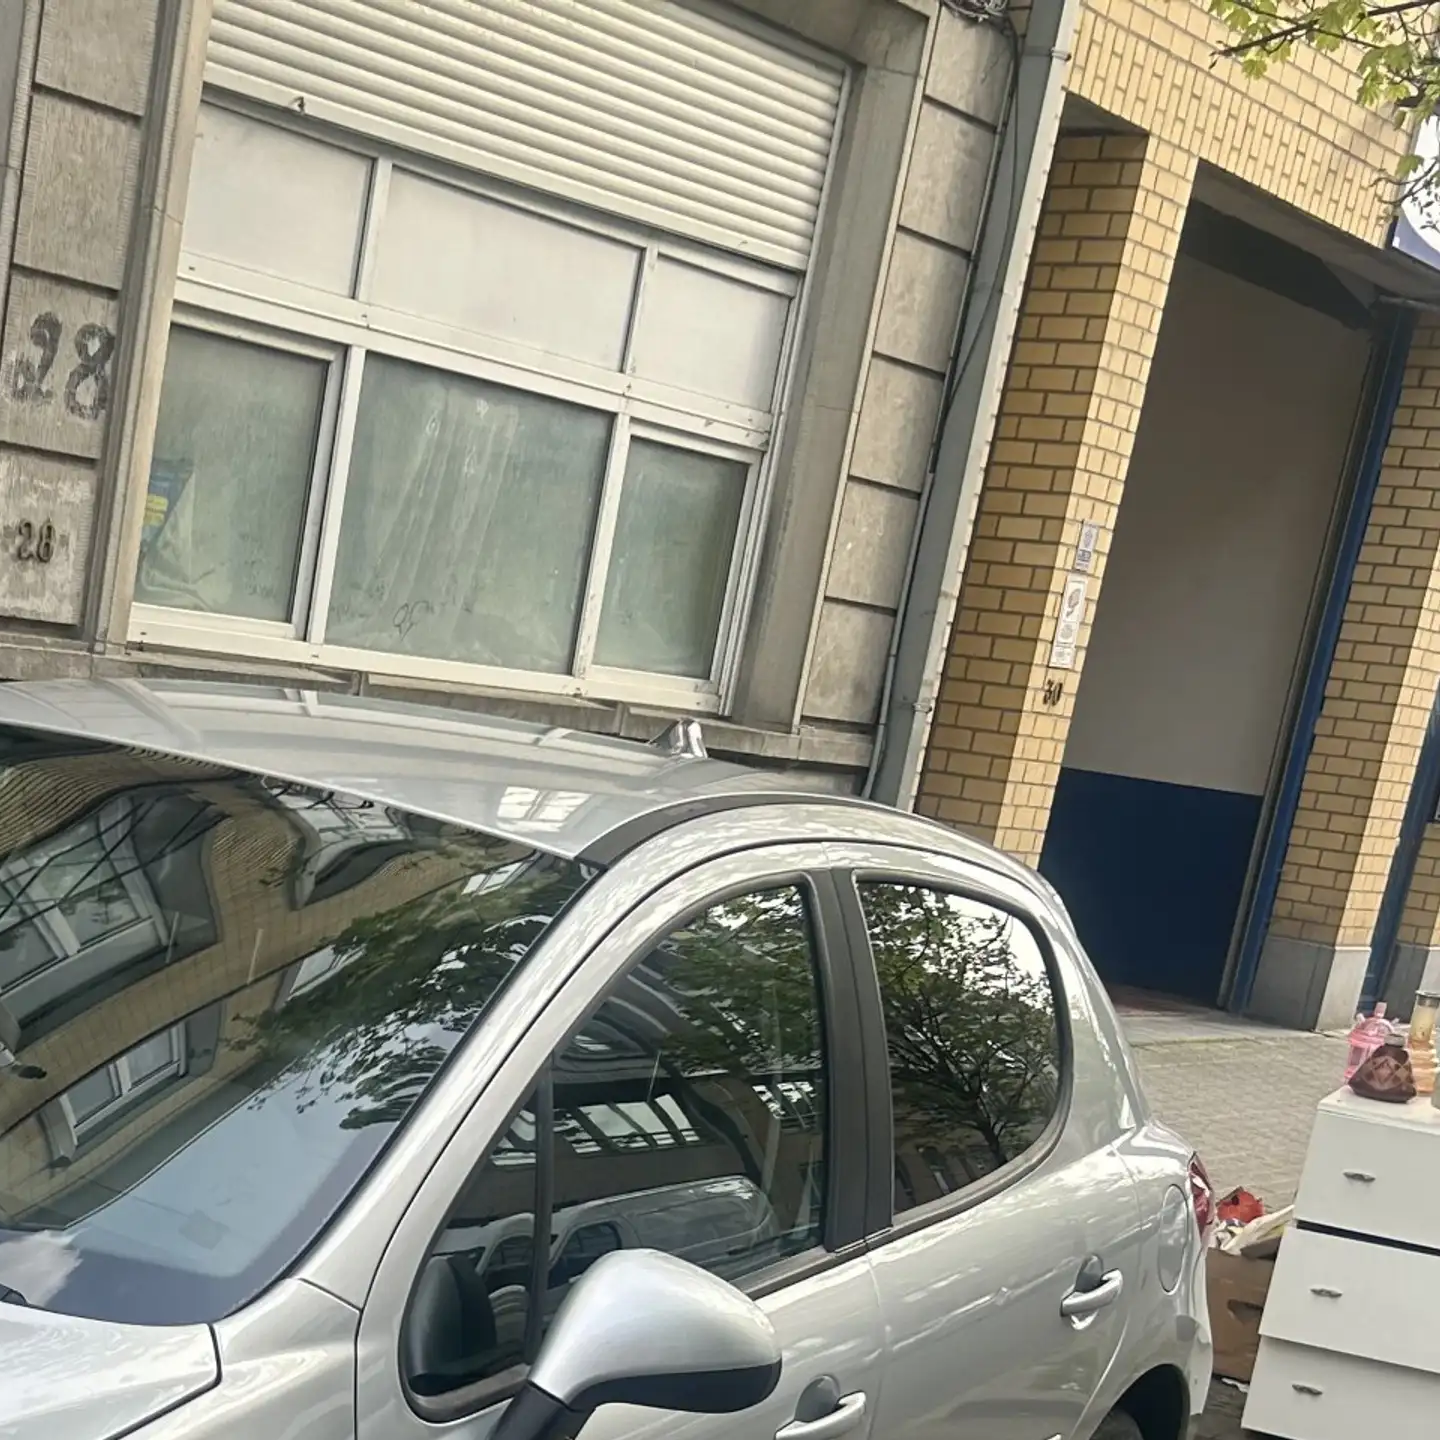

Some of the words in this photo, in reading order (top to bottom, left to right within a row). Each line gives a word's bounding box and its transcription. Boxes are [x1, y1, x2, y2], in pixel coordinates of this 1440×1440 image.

[12, 311, 115, 421] 28
[16, 518, 56, 564] 28
[1042, 679, 1064, 707] 30
